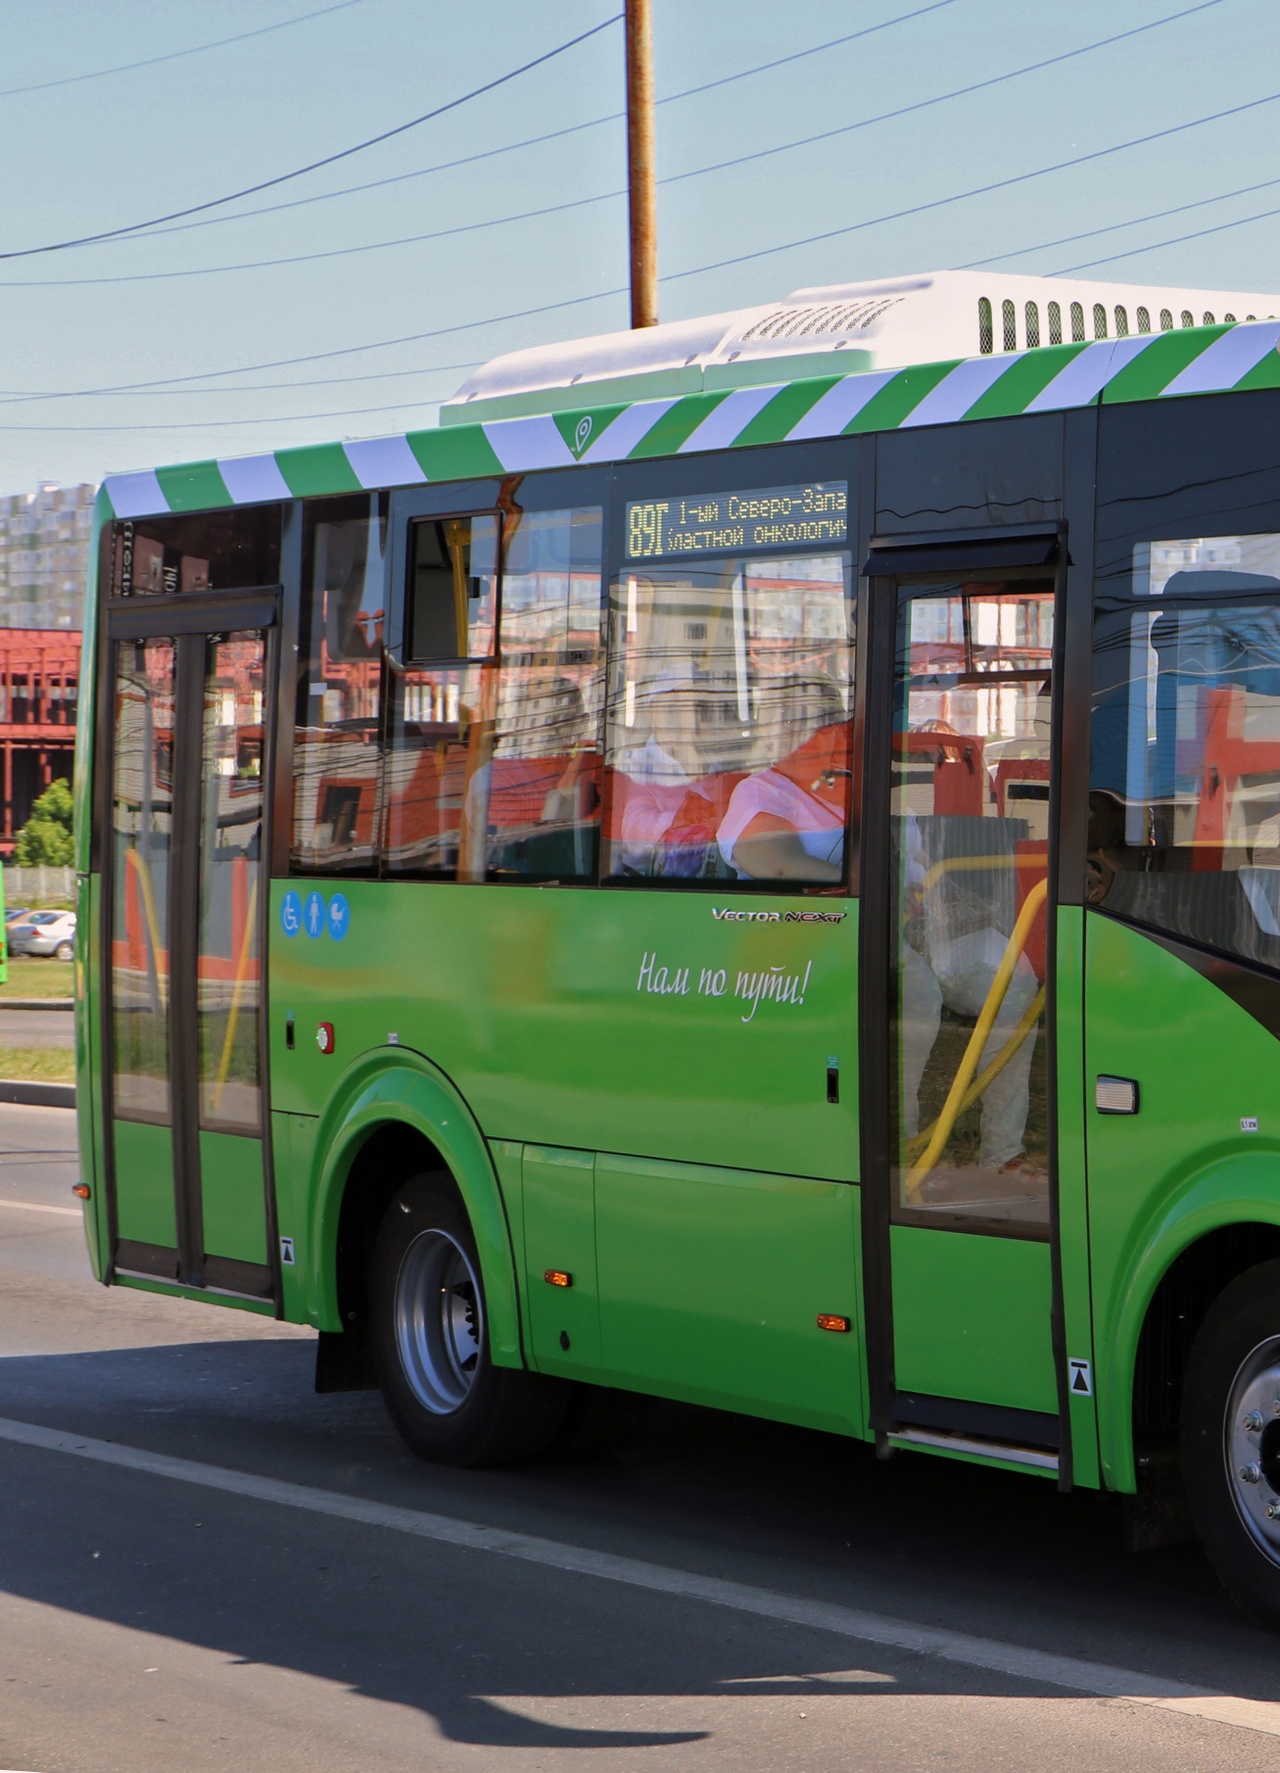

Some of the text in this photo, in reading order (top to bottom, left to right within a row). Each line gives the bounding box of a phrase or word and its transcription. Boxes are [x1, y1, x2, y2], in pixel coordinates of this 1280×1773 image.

[629, 502, 669, 557] 89Г
[680, 488, 847, 524] 1-ый Северо-Запа
[637, 951, 812, 1023] Нам по пути!
